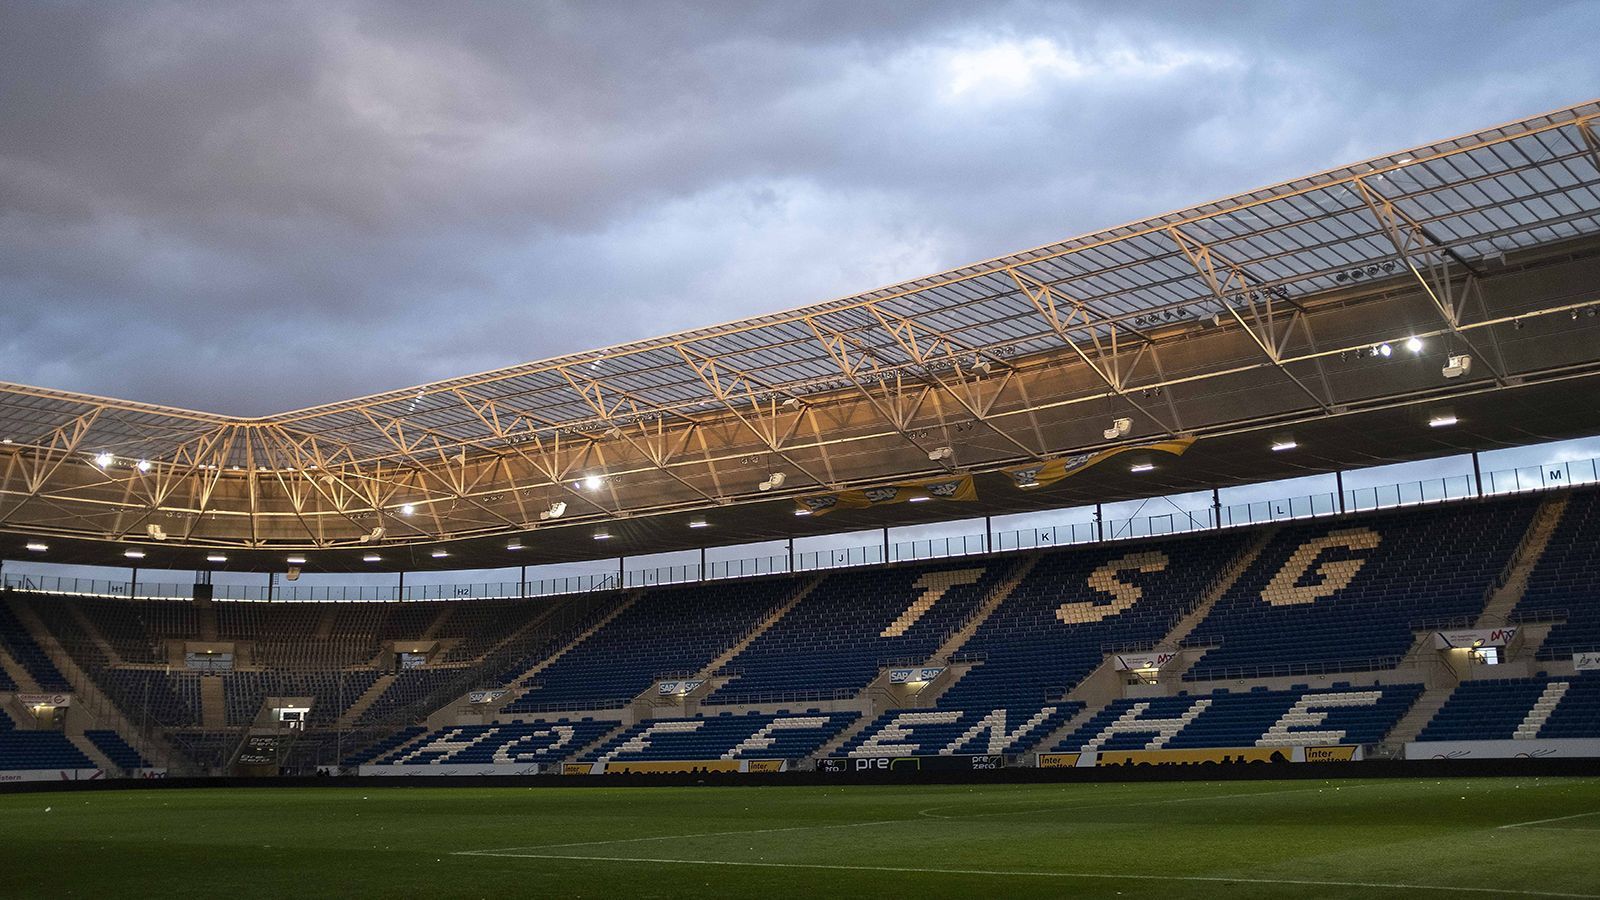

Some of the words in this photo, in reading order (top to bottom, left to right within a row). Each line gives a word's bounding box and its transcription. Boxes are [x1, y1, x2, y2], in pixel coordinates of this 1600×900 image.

[1550, 470, 1561, 480] M
[864, 487, 898, 503] SAP
[1277, 506, 1284, 514] L
[1042, 533, 1049, 541] K
[838, 554, 844, 562] J
[111, 585, 123, 593] H1
[457, 588, 469, 596] H2
[891, 671, 908, 681] SAP
[921, 670, 939, 680] SAP
[660, 683, 675, 693] SAP
[1308, 748, 1333, 758] inter
[972, 756, 989, 764] pre
[1041, 754, 1062, 764] inter
[750, 761, 768, 769] inter
[856, 758, 889, 771] pre
